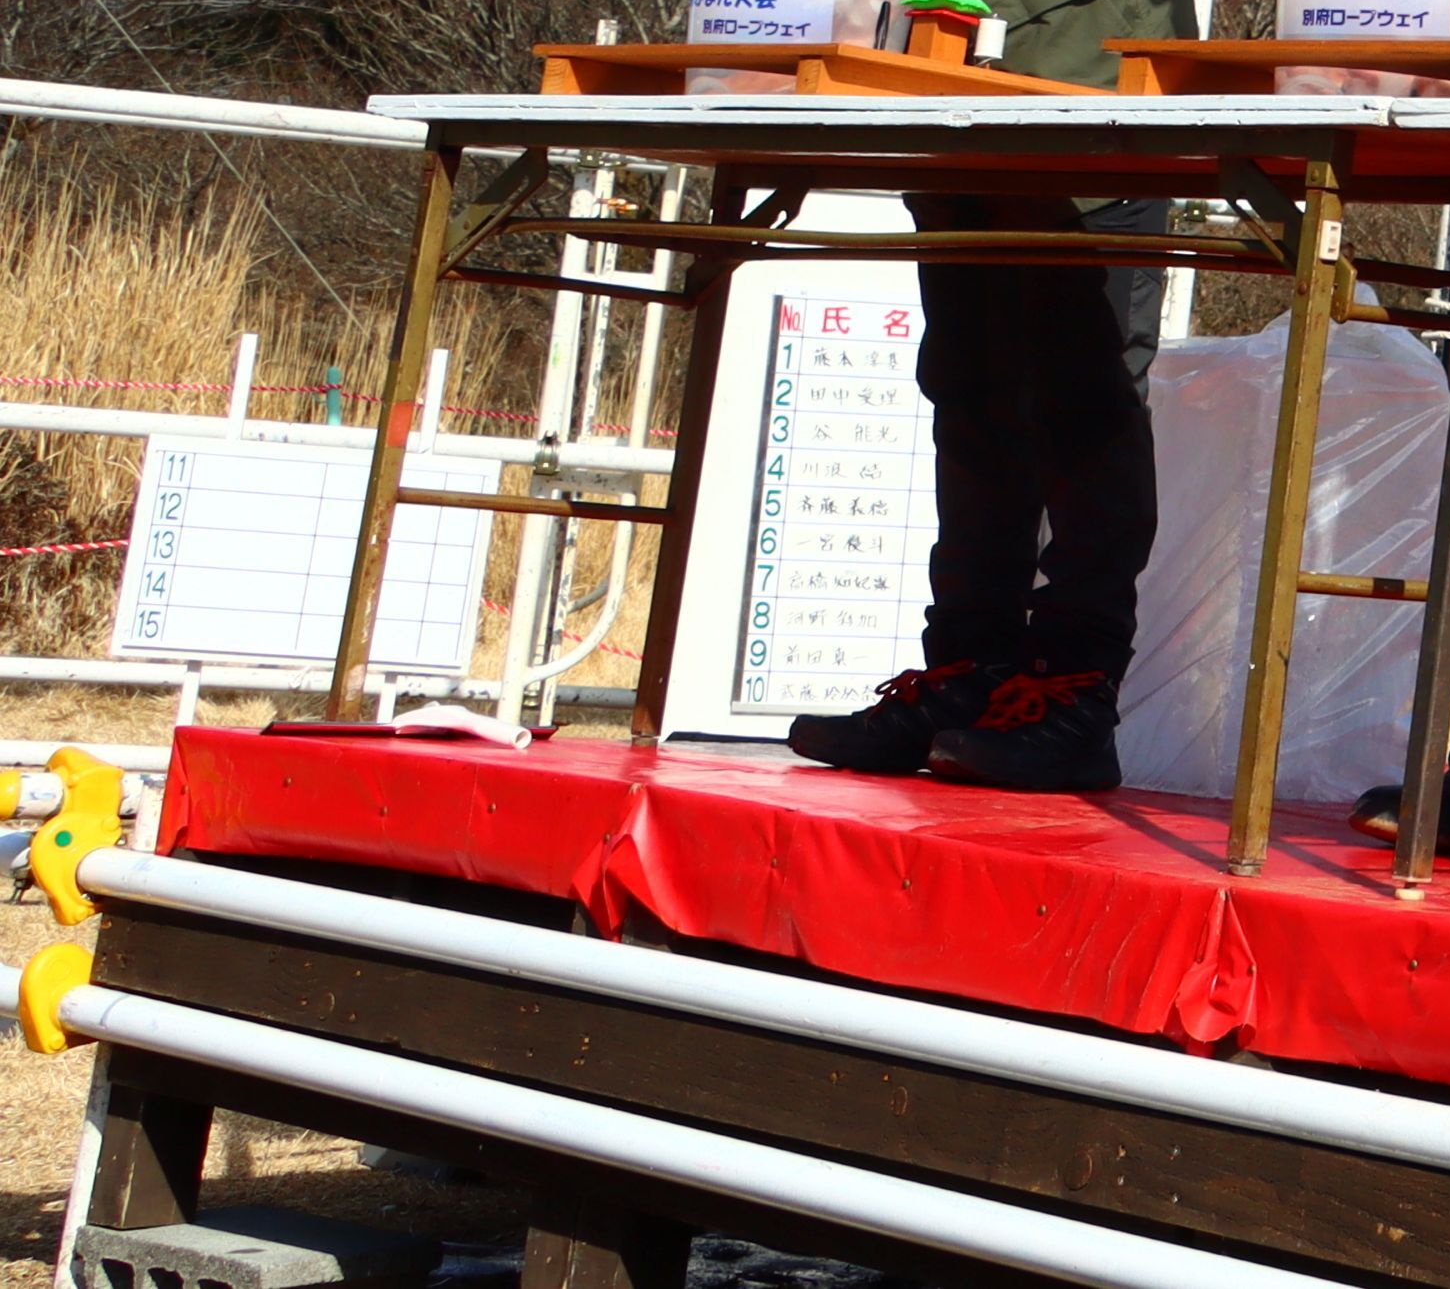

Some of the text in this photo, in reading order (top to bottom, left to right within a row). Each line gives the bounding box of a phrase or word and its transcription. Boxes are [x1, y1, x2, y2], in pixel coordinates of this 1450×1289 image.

[702, 18, 812, 38] 別府ロープウェイ
[1302, 8, 1430, 28] 別府ロープウェイ
[783, 342, 793, 370] 1
[775, 379, 793, 406] 2
[772, 415, 790, 443] 3
[167, 452, 188, 483] 11
[767, 454, 785, 481] 4
[159, 492, 182, 521] 12
[764, 489, 782, 516] 5
[152, 530, 175, 560] 13
[760, 527, 778, 555] 6
[144, 570, 166, 599] 14
[757, 564, 774, 592] 7
[137, 610, 161, 639] 15
[752, 601, 770, 629] 8
[749, 639, 767, 667] 9
[746, 676, 765, 703] 10
